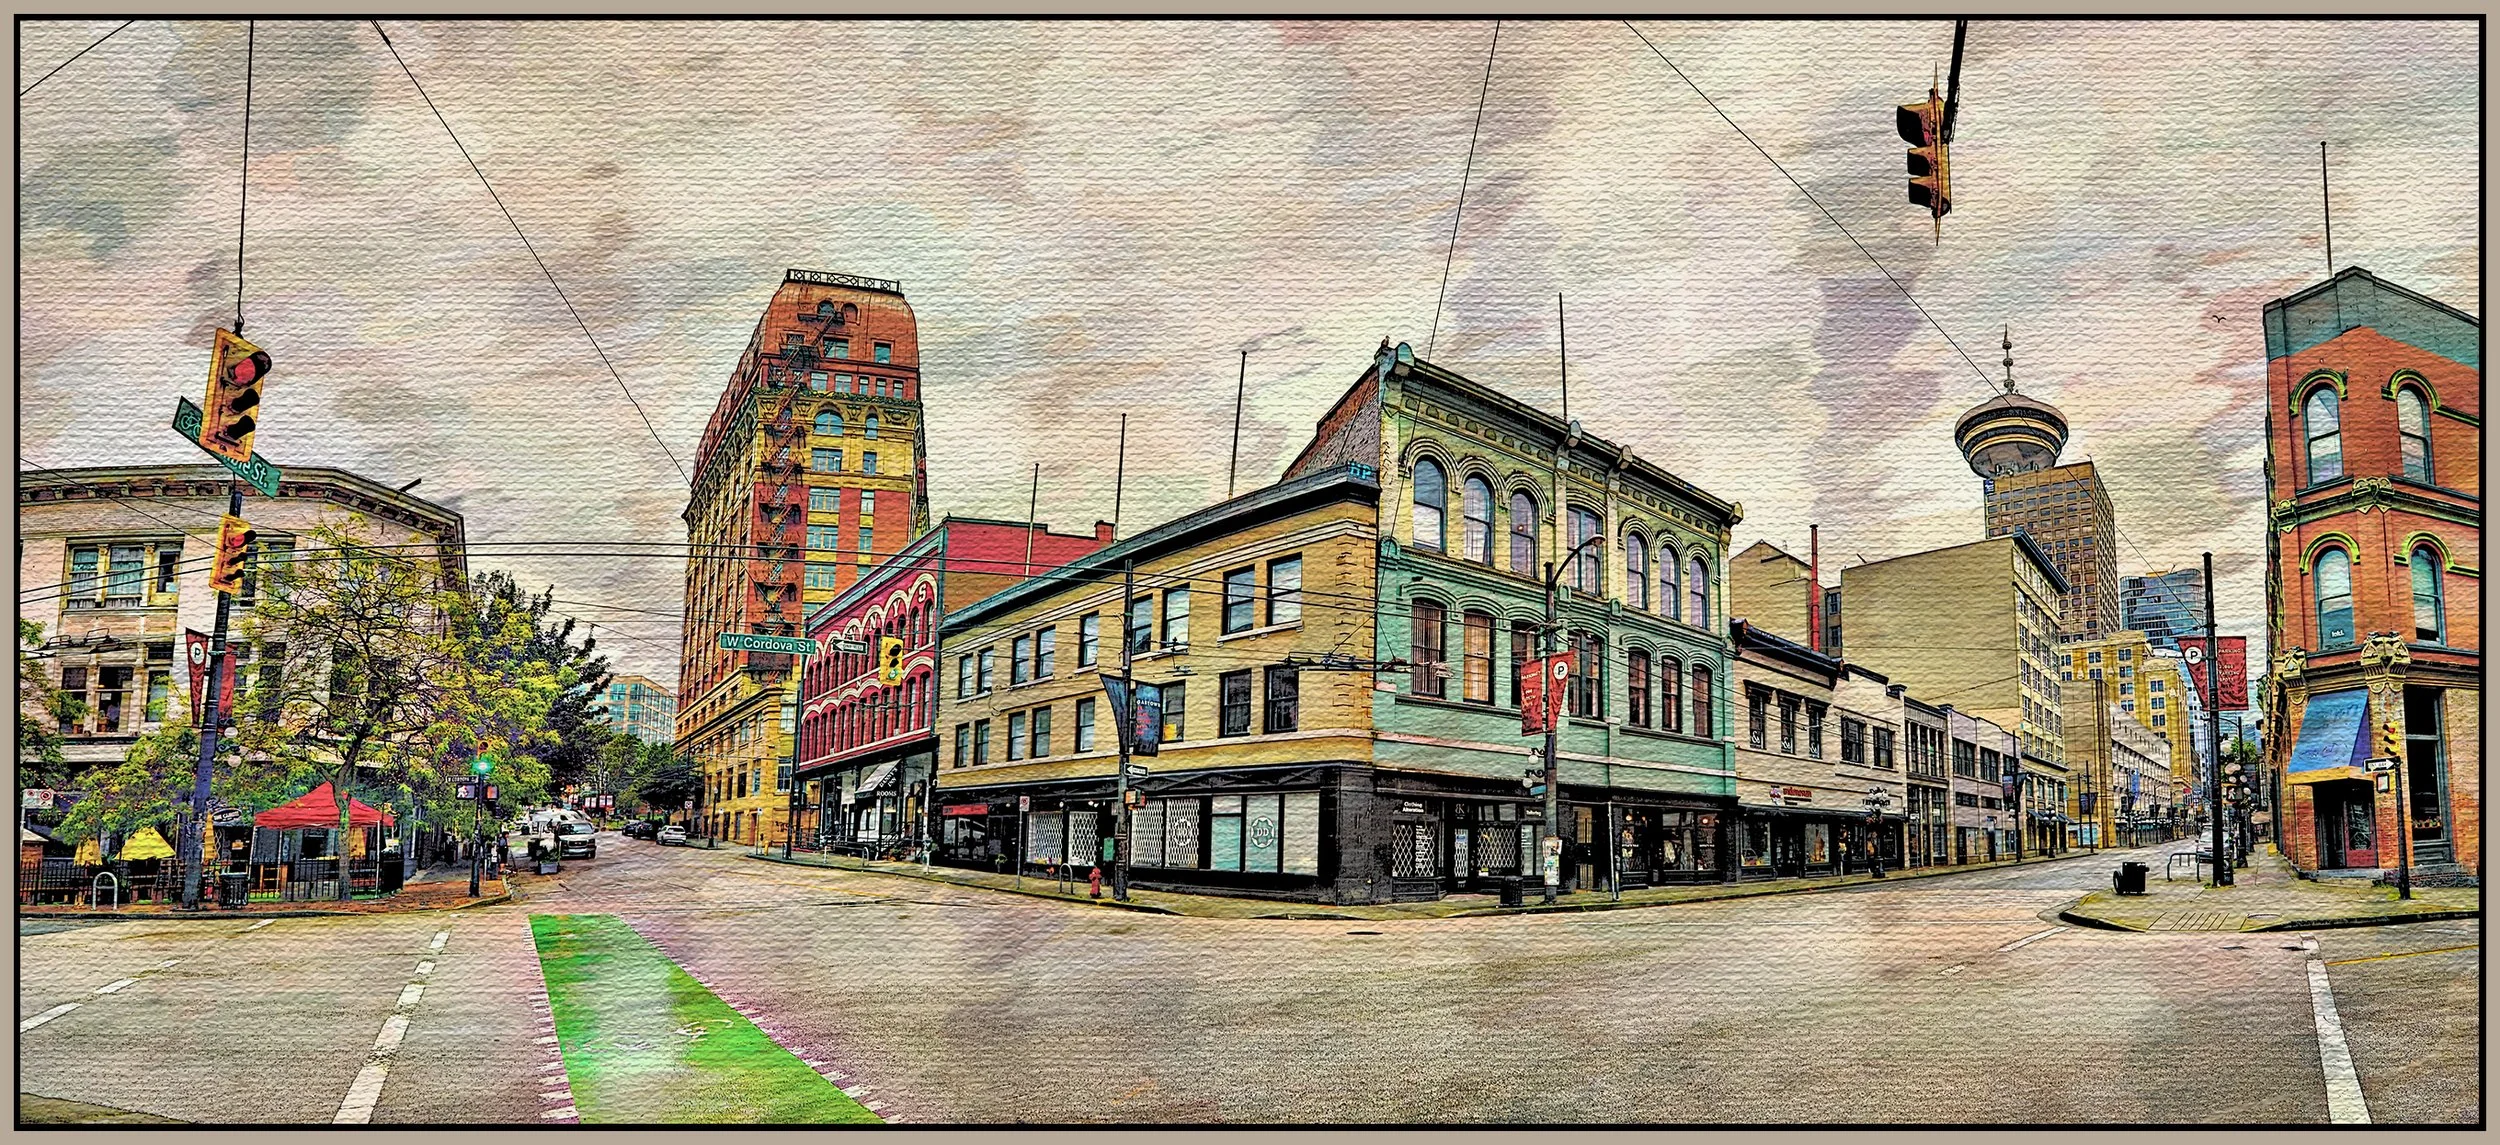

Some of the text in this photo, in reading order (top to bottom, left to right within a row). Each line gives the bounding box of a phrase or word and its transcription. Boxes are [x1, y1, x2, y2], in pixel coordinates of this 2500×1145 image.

[251, 462, 267, 487] St.
[726, 636, 810, 652] W Cordova St
[194, 647, 201, 658] P
[2190, 650, 2198, 660] P
[1557, 665, 1565, 676] P
[1256, 828, 1270, 838] DD
